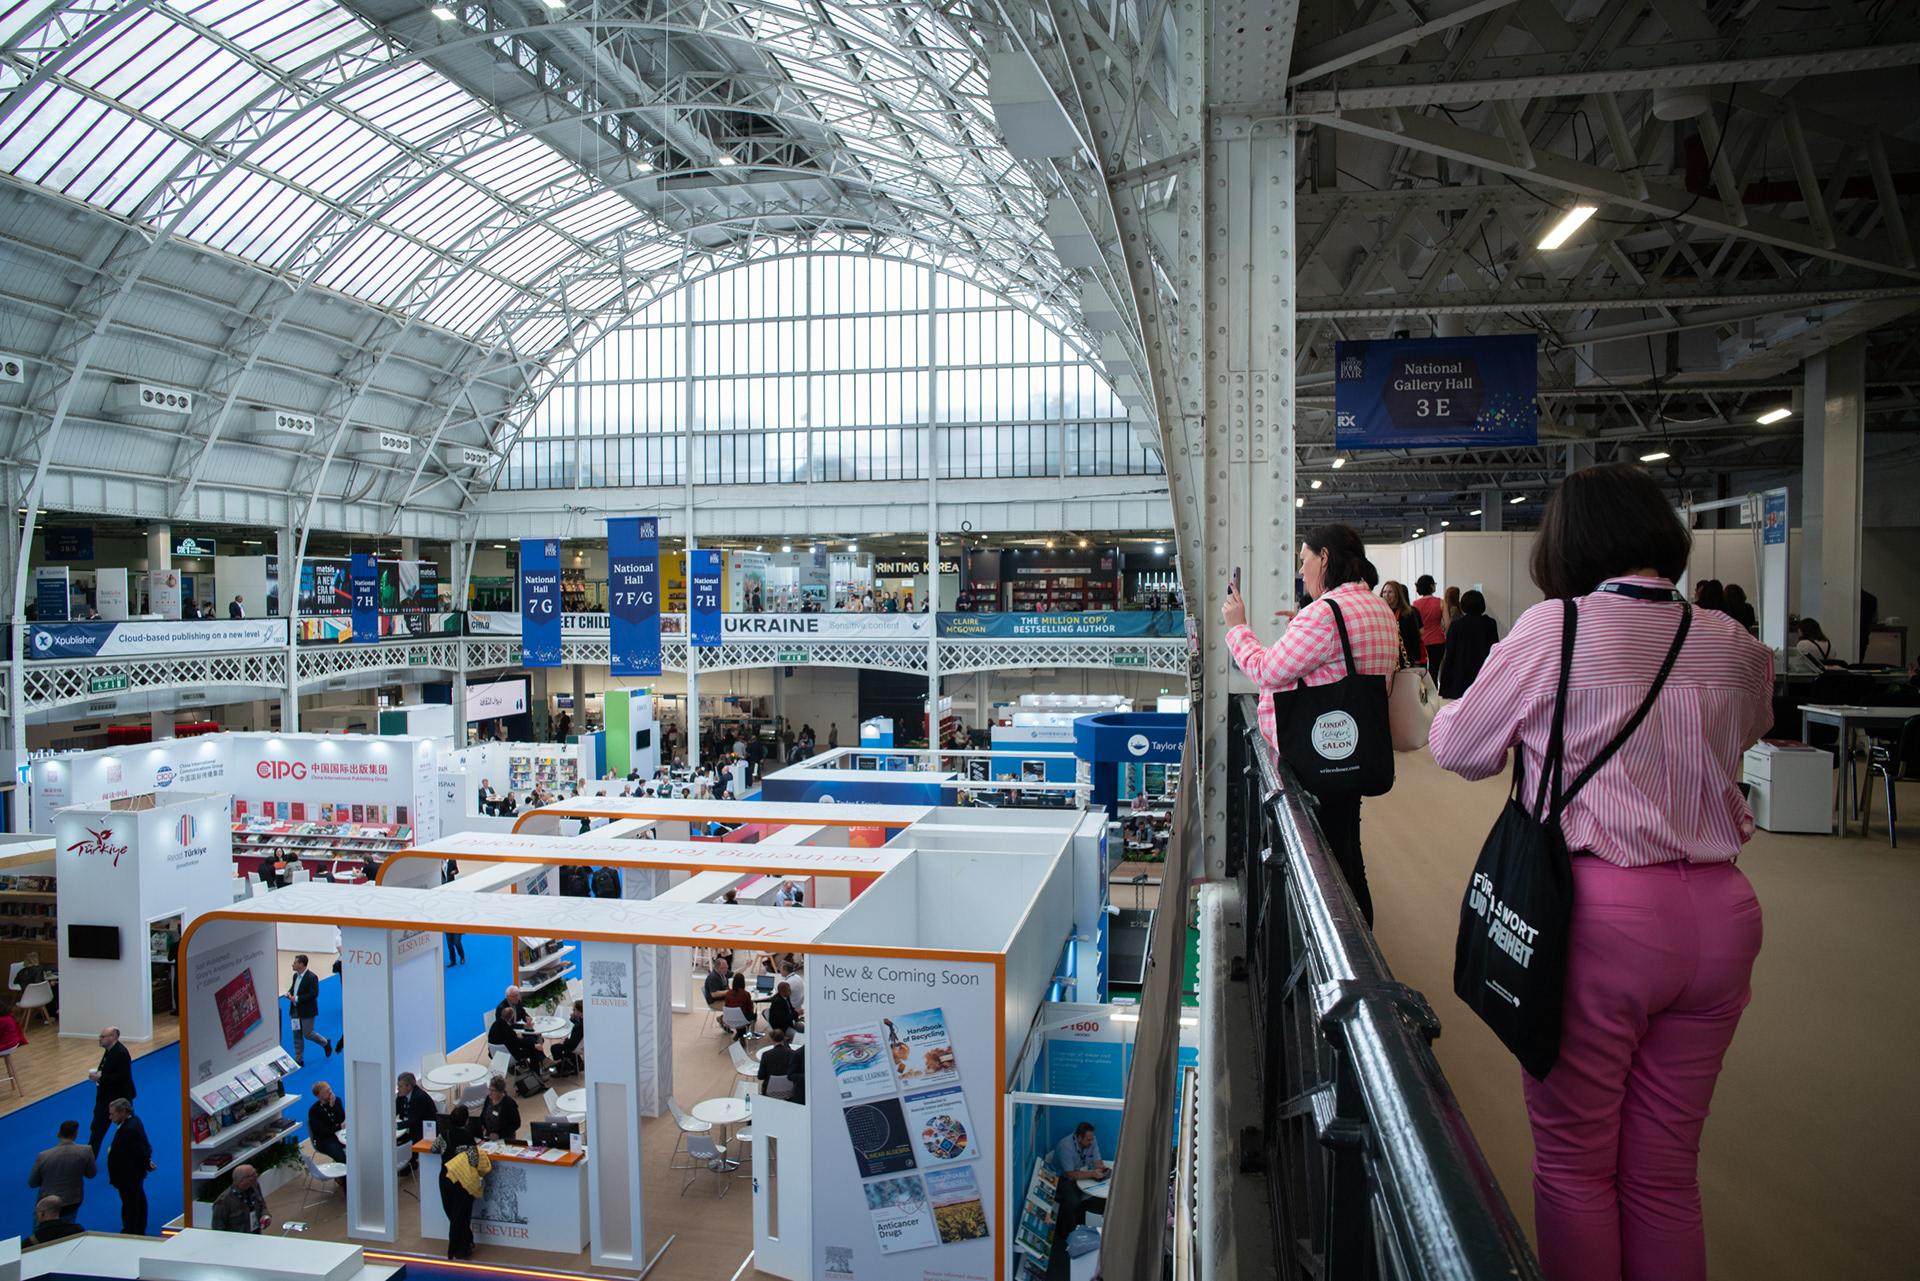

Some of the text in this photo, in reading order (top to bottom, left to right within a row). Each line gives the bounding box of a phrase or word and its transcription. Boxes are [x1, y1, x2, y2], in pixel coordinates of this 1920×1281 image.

[1340, 364, 1362, 372] BOOK
[1404, 362, 1462, 375] National
[1340, 370, 1362, 378] FAIR
[1394, 378, 1473, 392] Gallery Hall
[1416, 399, 1450, 417] 3 E
[1338, 416, 1356, 427] RX
[614, 563, 654, 573] National
[923, 562, 959, 572] KREA
[317, 576, 334, 585] A NEW
[525, 576, 556, 584] National
[624, 576, 643, 584] Hall
[318, 586, 335, 594] ERA IN
[318, 595, 336, 604] PRINT
[357, 596, 374, 606] 7 H
[615, 591, 653, 606] 7 F/G
[696, 595, 716, 606] 7 H
[529, 599, 552, 613] 7 G
[472, 621, 490, 629] CHILD
[561, 616, 610, 628] EET CHILD
[724, 619, 819, 632] UKRAINE
[879, 621, 899, 629] content
[1082, 616, 1107, 624] COPY
[1014, 625, 1074, 633] BESTSELLING
[54, 635, 96, 646] Xpublisher
[119, 633, 170, 643] Cloud-based
[172, 631, 210, 642] publishing
[1319, 720, 1347, 728] LONDON
[1152, 742, 1176, 752] Taylor
[1322, 741, 1352, 750] SALON
[256, 761, 307, 780] CIPG
[311, 762, 387, 775] 中国国际出版集团
[450, 839, 535, 848] world
[540, 843, 631, 853] better
[67, 838, 128, 867] Türkiye
[167, 847, 206, 862] Read Türkiye
[661, 848, 706, 856] for
[715, 850, 880, 863] Partnering
[1473, 872, 1539, 944] FÜR WORT
[692, 923, 789, 938] 7F20
[398, 934, 430, 955] ELSEVIER
[1488, 918, 1534, 969] REIHEIT
[348, 950, 382, 966] 7F20
[196, 963, 205, 972] Just
[196, 969, 212, 980] Gray's
[213, 961, 235, 973] Anatomy
[824, 964, 979, 987] New & Coming Soon
[204, 976, 220, 987] Edition
[228, 983, 250, 1003] ANATOMY
[824, 987, 895, 1004] in Science
[591, 998, 628, 1007] ELSEVIER
[907, 1023, 943, 1035] Handbook
[911, 1030, 945, 1040] Recycling
[842, 1070, 889, 1085] MACHINE LEARNING
[867, 1147, 910, 1159] LINEAR ALGEBRA
[928, 1171, 970, 1183] SUSTAINABLE
[878, 1219, 919, 1231] Anticancer
[471, 1223, 529, 1239] ELSEVIER
[879, 1228, 902, 1238] Drugs
[825, 1272, 854, 1280] ELSEVIER
